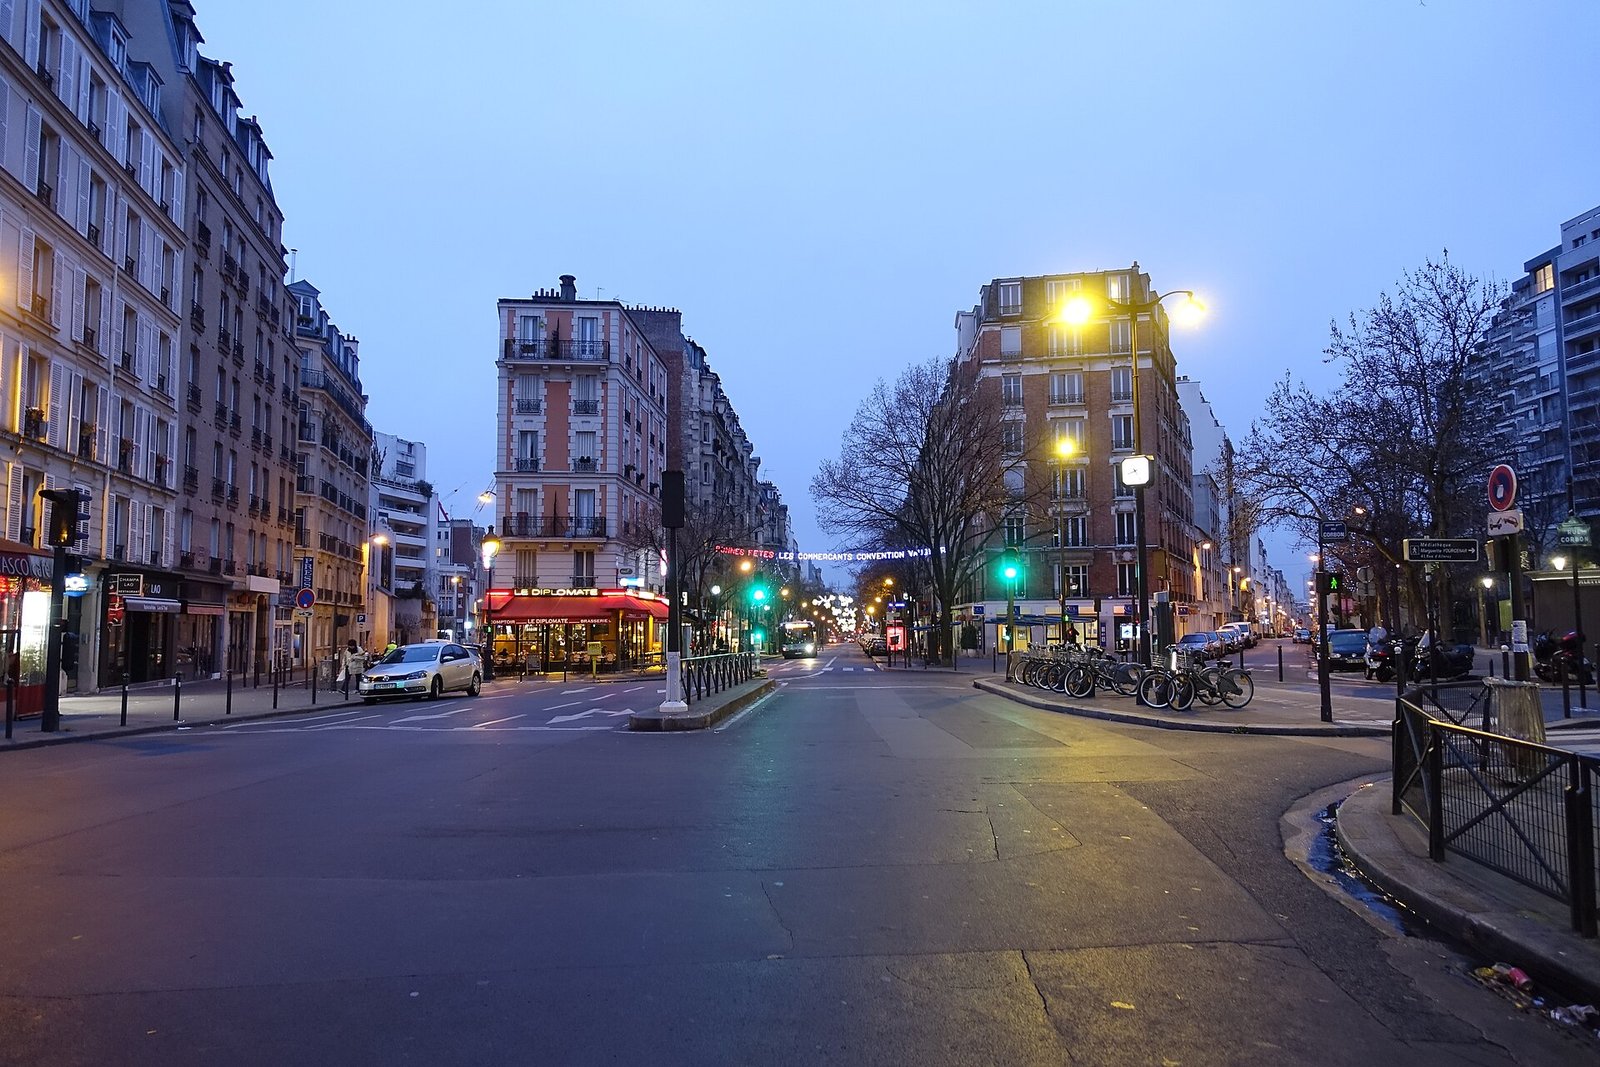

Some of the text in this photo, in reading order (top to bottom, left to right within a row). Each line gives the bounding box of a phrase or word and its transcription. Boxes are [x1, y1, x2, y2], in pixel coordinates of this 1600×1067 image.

[778, 552, 794, 560] LES
[856, 551, 905, 560] CONVENTION
[0, 556, 30, 576] ASCO
[303, 557, 313, 589] PRESS
[150, 584, 161, 594] LAO
[513, 588, 599, 596] LE DIPLOMATE
